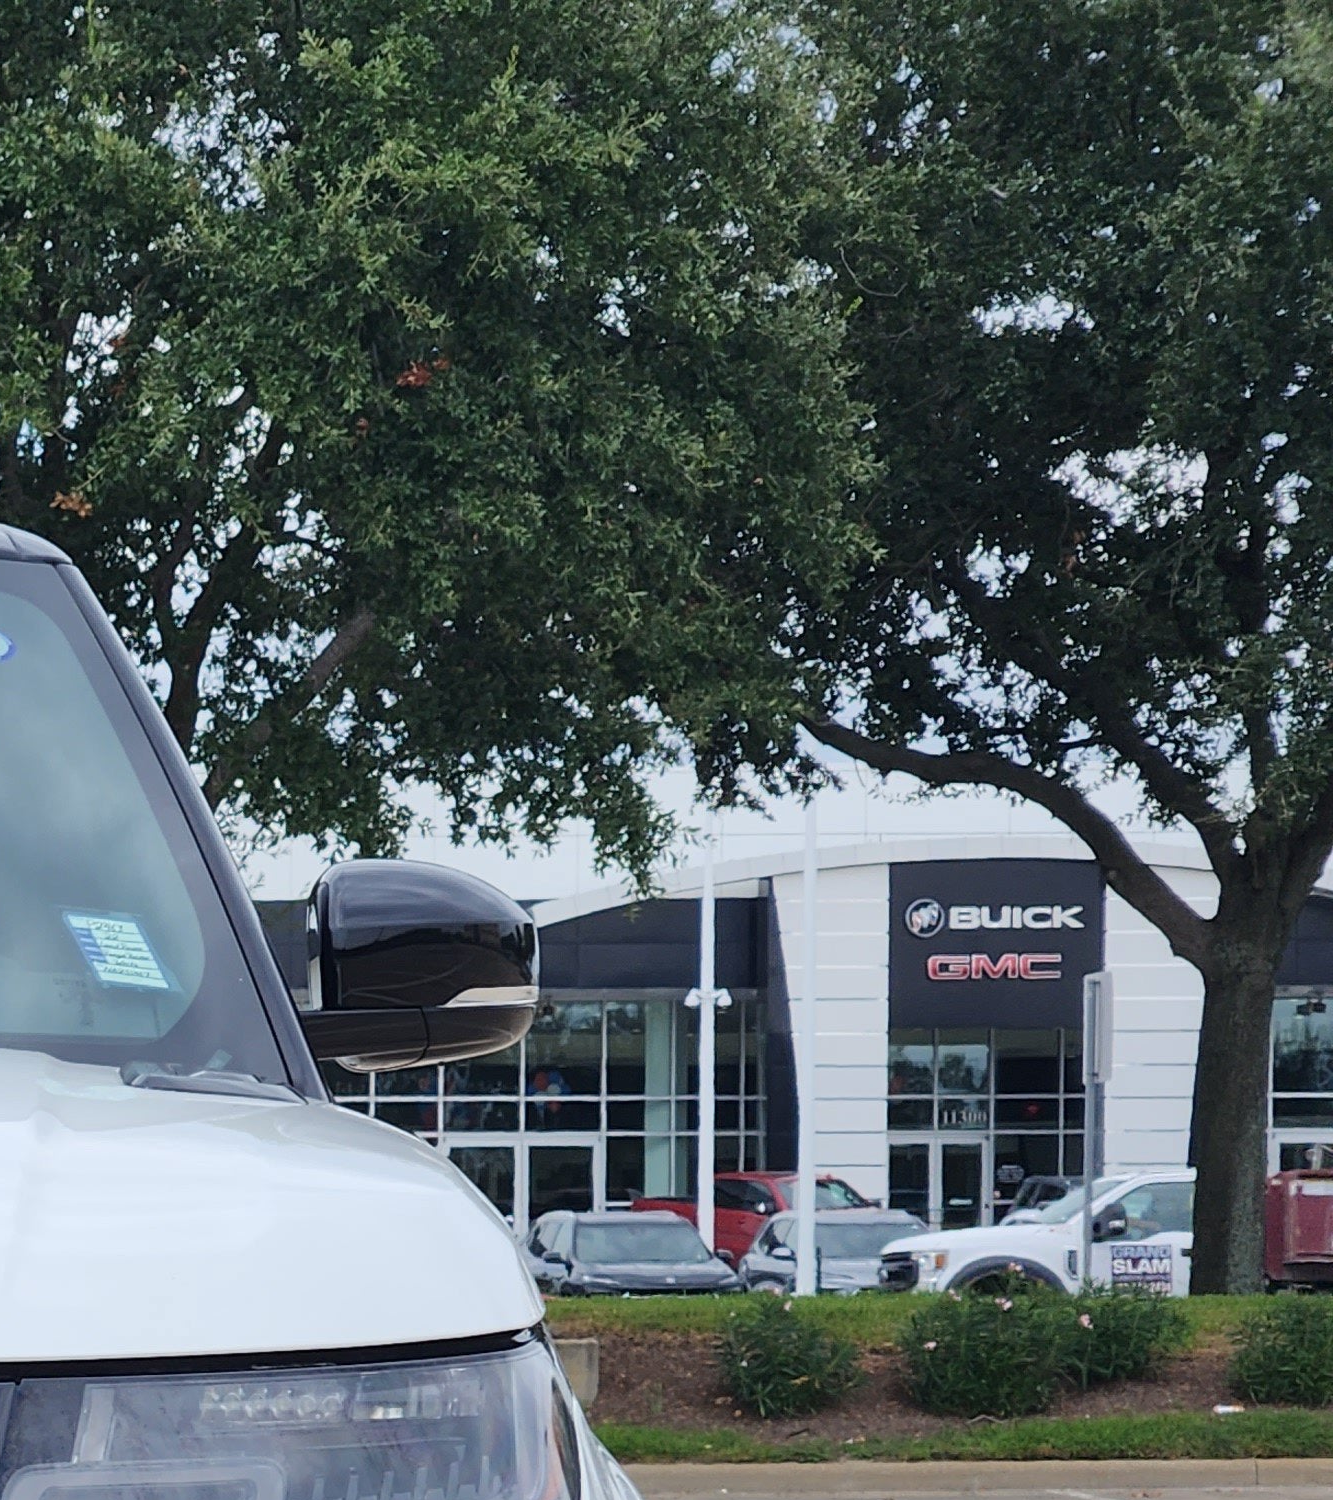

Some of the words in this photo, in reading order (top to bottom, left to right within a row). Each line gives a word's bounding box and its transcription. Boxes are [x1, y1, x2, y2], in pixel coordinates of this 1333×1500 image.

[948, 905, 1086, 931] BUICK
[927, 953, 1063, 980] GMC
[1112, 1246, 1171, 1259] GRAND
[1112, 1259, 1171, 1275] SLAM
